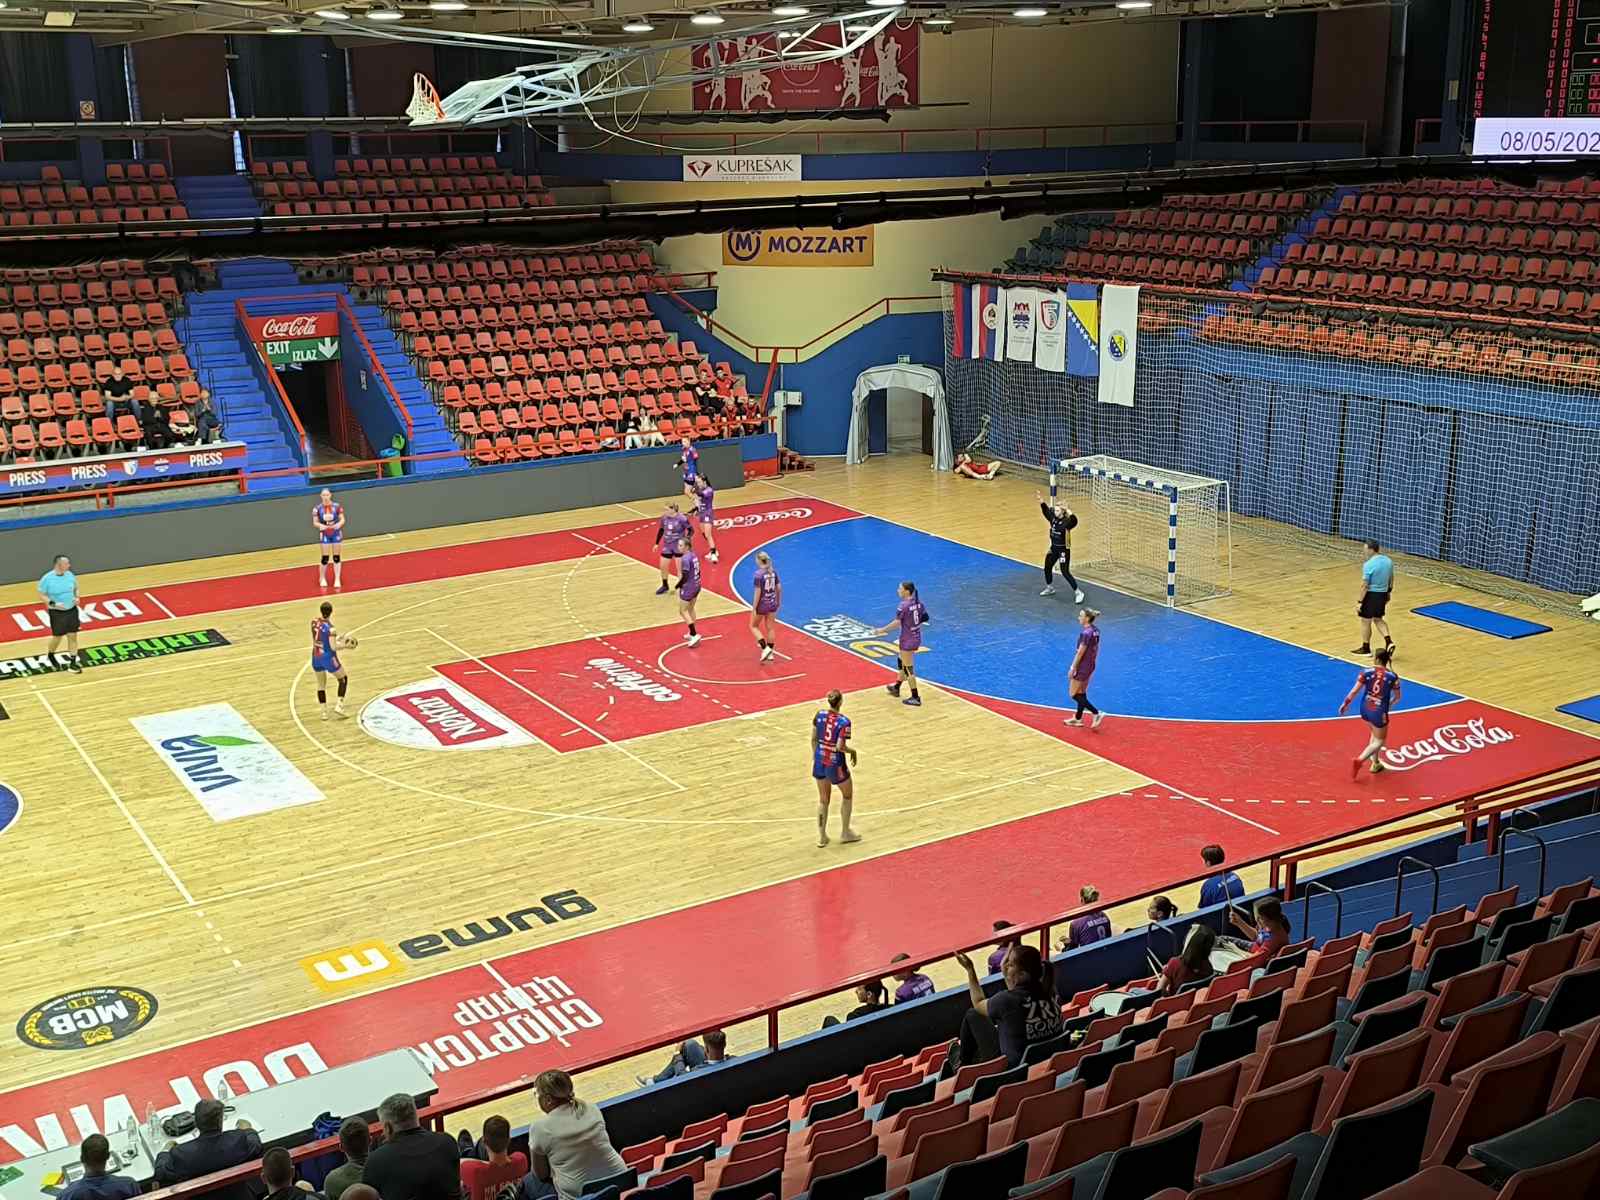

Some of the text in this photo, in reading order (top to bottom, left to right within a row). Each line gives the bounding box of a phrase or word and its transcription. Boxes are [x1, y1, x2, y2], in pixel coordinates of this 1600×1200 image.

[717, 157, 794, 174] KUPREŠAK
[768, 235, 868, 254] MOZZART
[262, 315, 320, 339] Coca-Cola
[266, 341, 290, 355] EXIT
[292, 349, 318, 361] IZLAZ
[9, 451, 224, 488] PRESS PRESS PRESS
[85, 630, 211, 661] ПРИНТ
[1372, 679, 1380, 694] 6
[409, 696, 488, 740] Nektar
[824, 723, 833, 741] 5
[398, 888, 598, 960] guma
[48, 1000, 129, 1035] MCB
